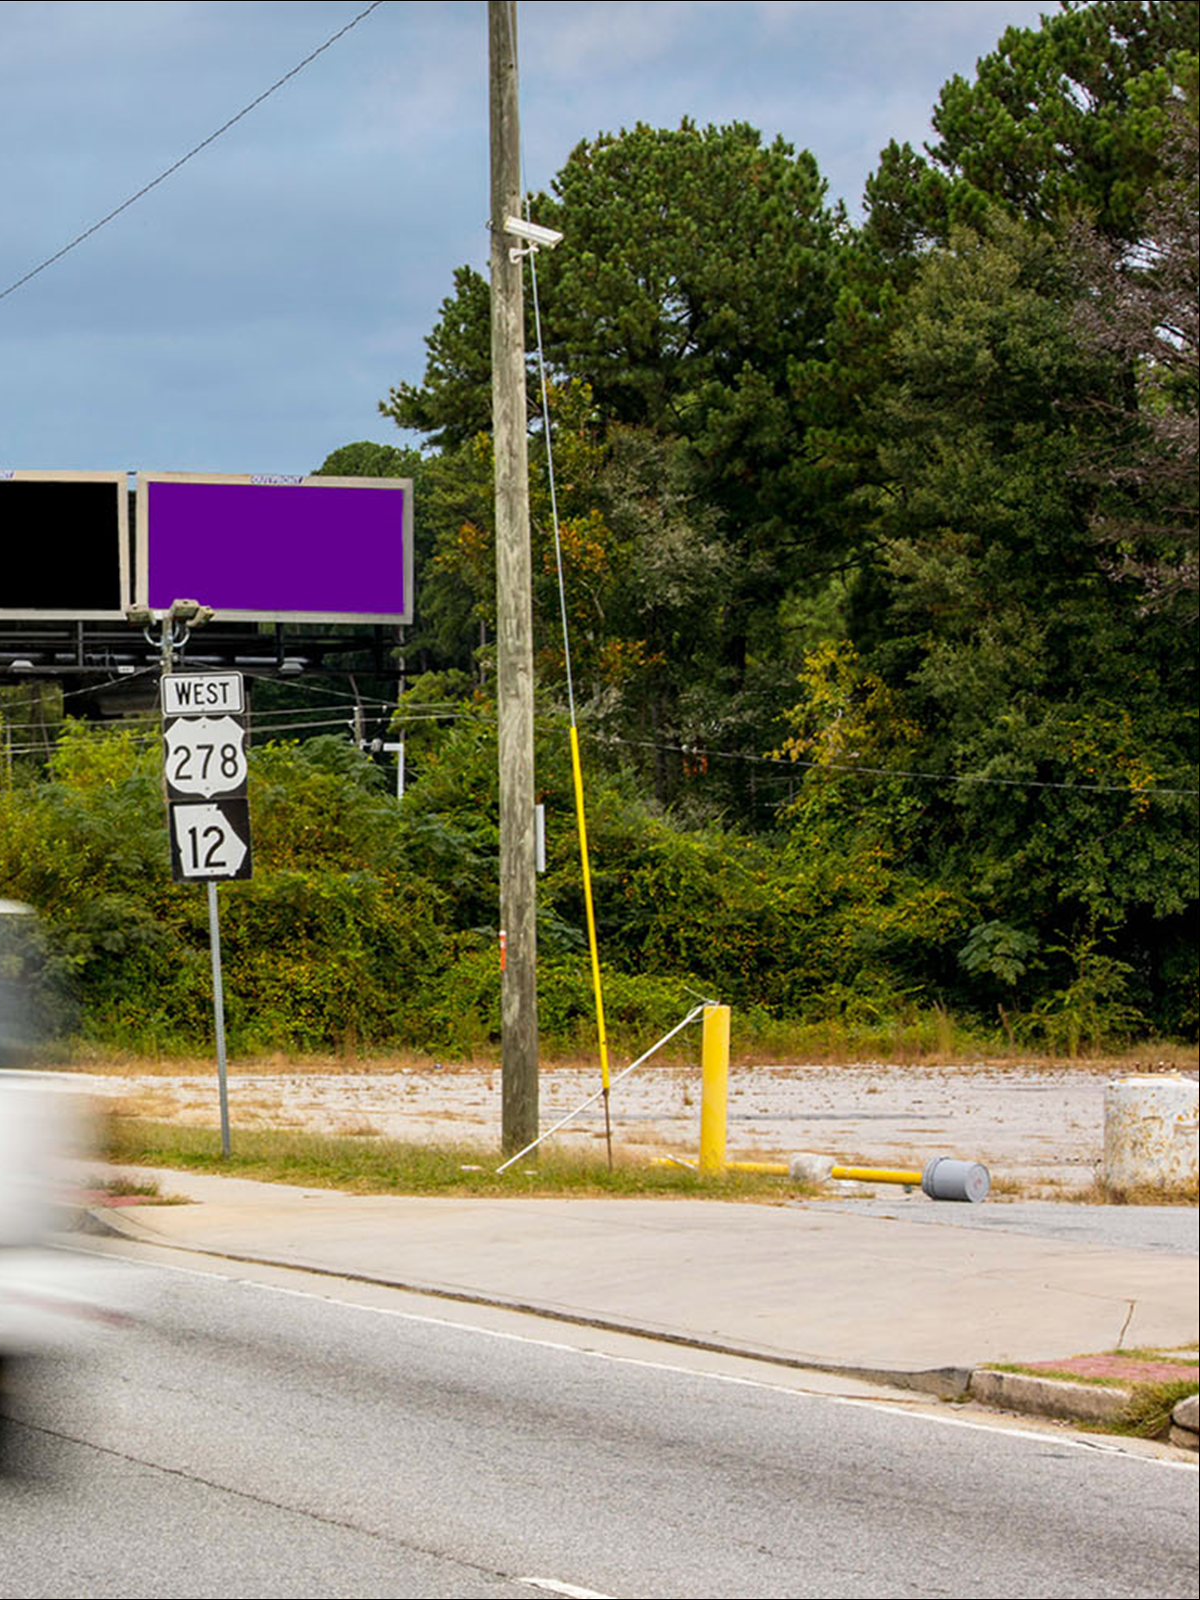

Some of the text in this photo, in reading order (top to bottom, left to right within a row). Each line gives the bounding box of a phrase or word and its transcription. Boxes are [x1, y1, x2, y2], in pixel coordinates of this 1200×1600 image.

[175, 682, 230, 705] WEST
[173, 743, 238, 780] 278
[188, 825, 227, 869] 12
